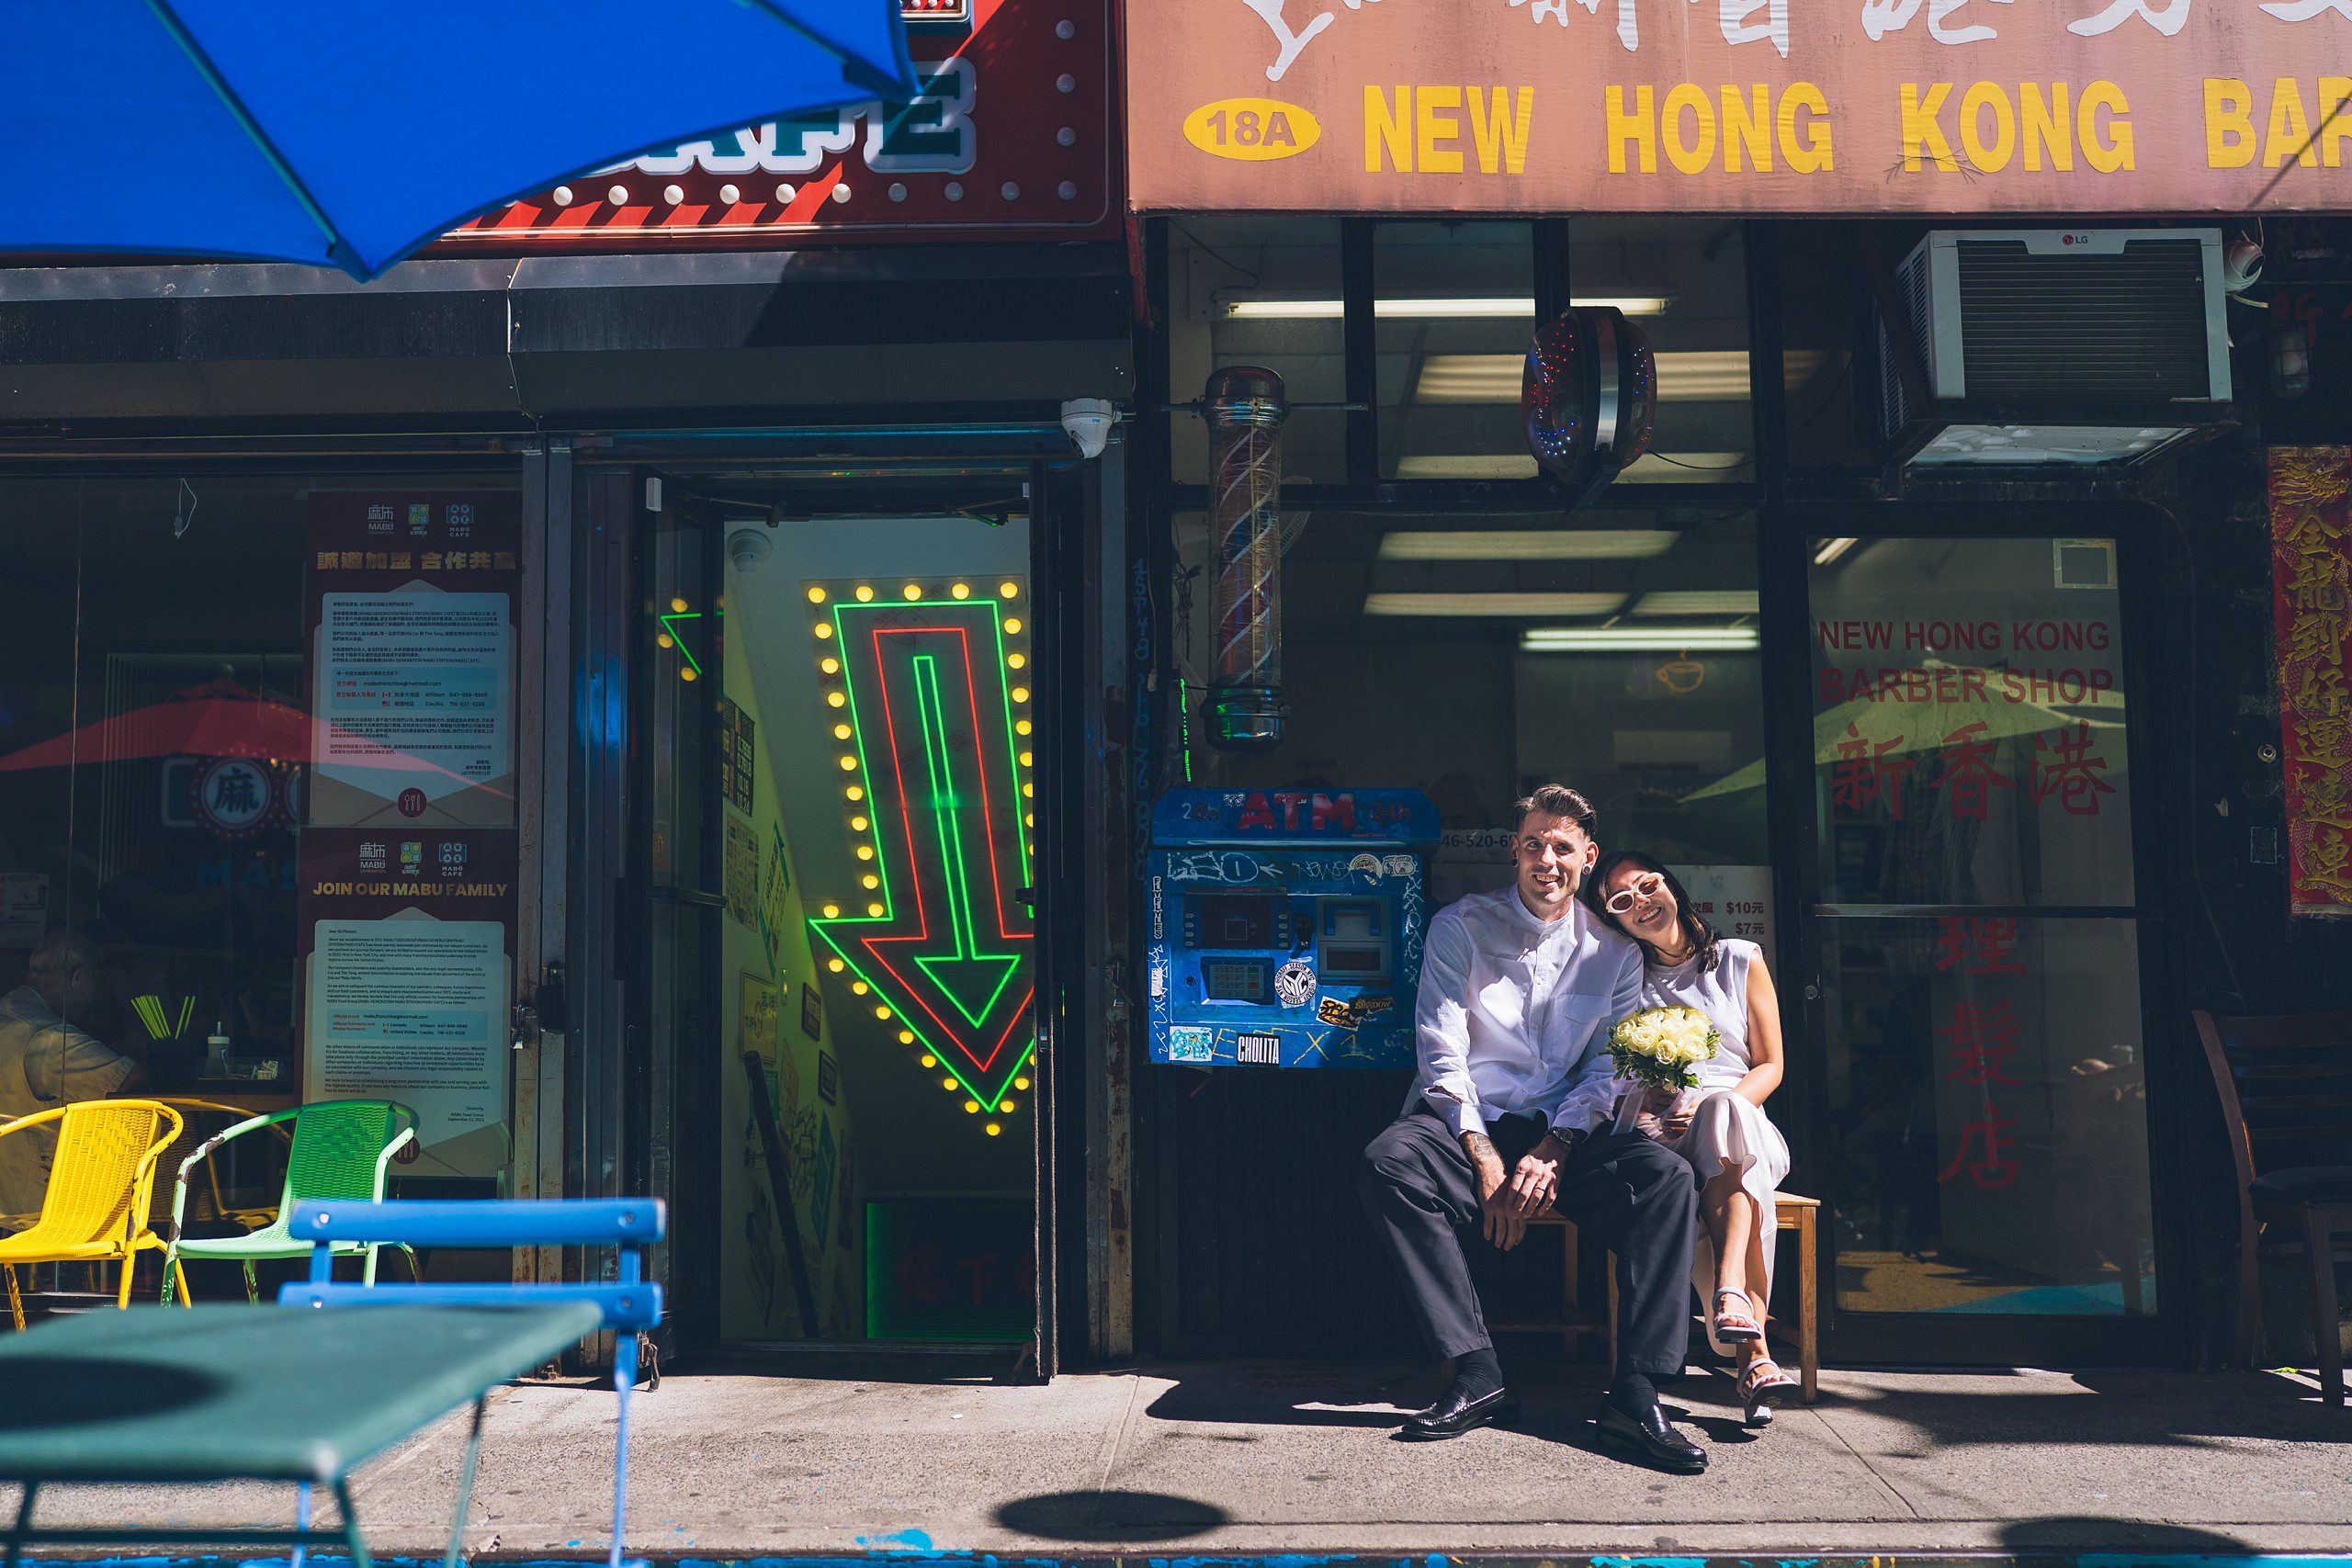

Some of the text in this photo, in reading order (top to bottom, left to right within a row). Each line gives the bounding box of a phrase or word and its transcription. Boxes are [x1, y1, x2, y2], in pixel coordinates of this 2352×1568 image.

[1206, 110, 1296, 147] 18A
[1363, 85, 1534, 175] NEW
[1605, 82, 1834, 175] HONG
[1899, 80, 2135, 175] KONG
[2075, 236, 2088, 244] LG
[1819, 621, 2109, 651] NEW HONG KONG
[1819, 667, 2113, 704] BARBER SHOP
[1829, 719, 2116, 822] 新香港
[1238, 793, 1355, 830] ATM
[1372, 805, 1411, 822] 24h
[360, 860, 386, 869] MABÚ
[313, 883, 507, 896] JOIN OUR MABU FAMILY
[1726, 901, 1764, 914] $10元
[1736, 922, 1764, 935] $7元
[1283, 971, 1308, 997] NYC
[1238, 1036, 1280, 1064] CHOLITA
[1935, 917, 2027, 1188] 理髮店
